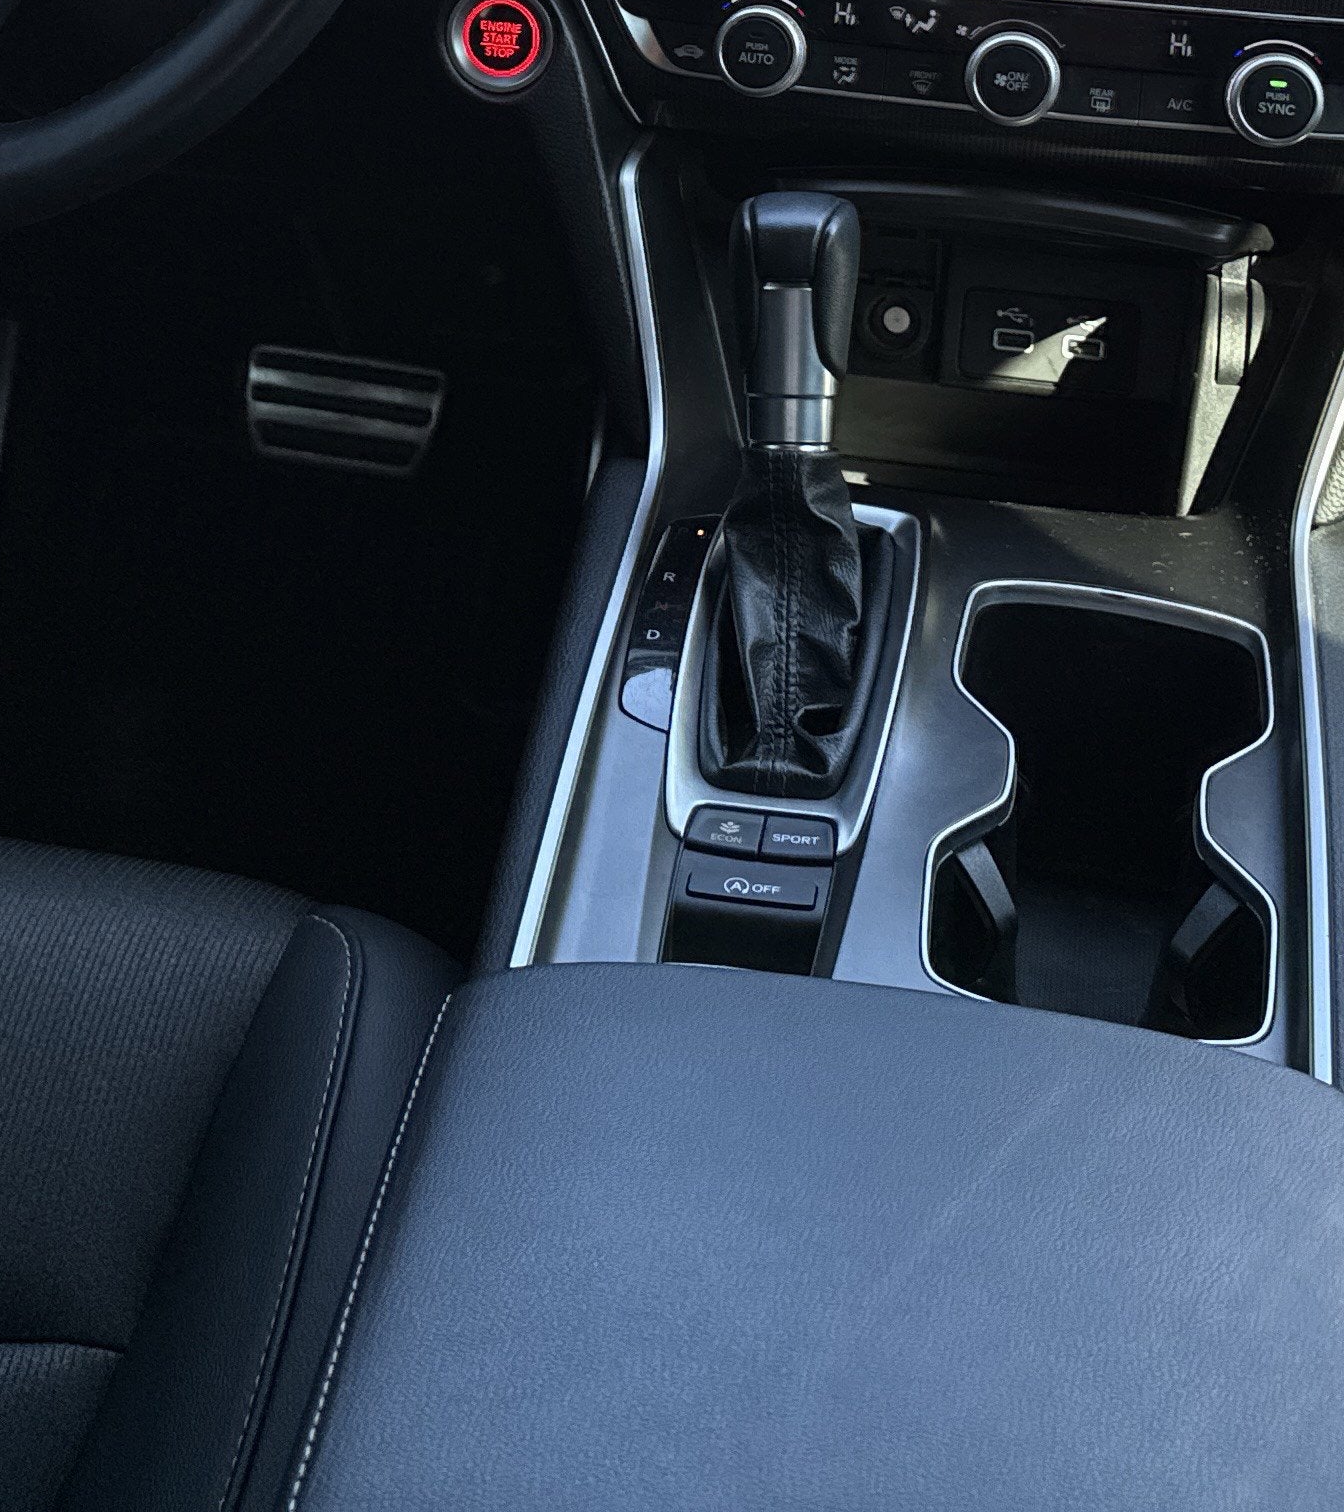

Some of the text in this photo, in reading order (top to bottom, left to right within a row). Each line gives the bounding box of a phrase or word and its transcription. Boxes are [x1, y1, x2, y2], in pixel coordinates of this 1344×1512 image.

[480, 20, 522, 34] ENGINE
[482, 32, 518, 45] START
[484, 47, 515, 58] STOP
[745, 41, 768, 52] PUSH
[738, 52, 775, 66] AUTO
[833, 55, 858, 66] MODE
[1006, 80, 1029, 92] OFF
[1089, 88, 1113, 97] REAR
[1265, 91, 1290, 102] PUSH
[1167, 98, 1193, 112] A/C
[1258, 101, 1297, 117] SYNC
[663, 571, 677, 583] R
[646, 629, 661, 640] D
[710, 831, 743, 845] ECON
[772, 831, 821, 846] SPORT
[751, 882, 782, 895] OFF
